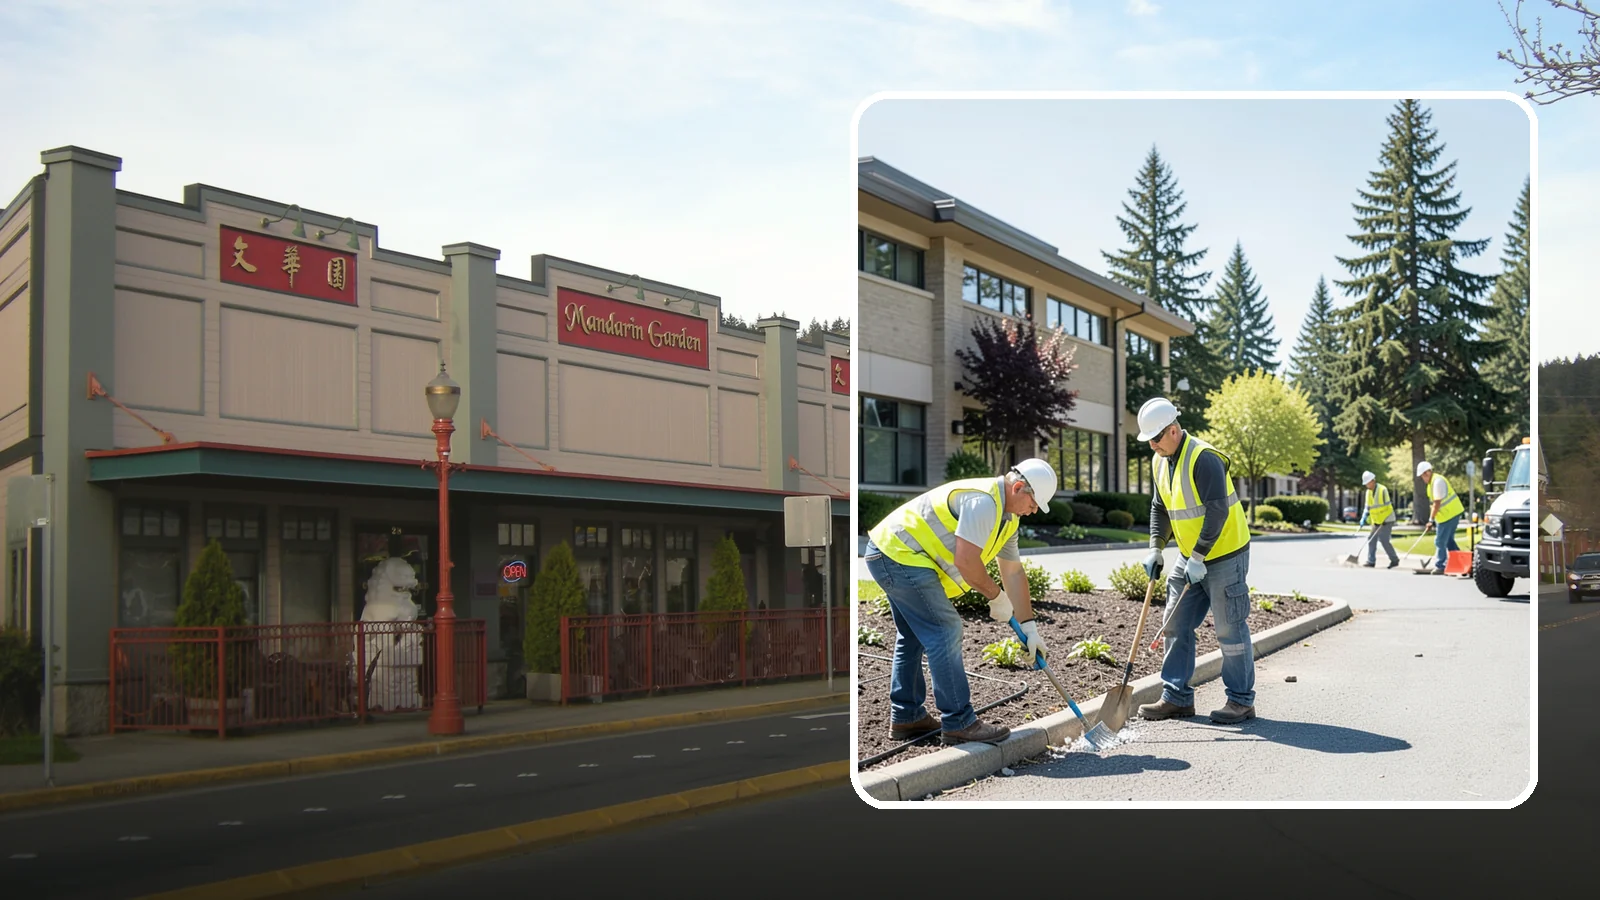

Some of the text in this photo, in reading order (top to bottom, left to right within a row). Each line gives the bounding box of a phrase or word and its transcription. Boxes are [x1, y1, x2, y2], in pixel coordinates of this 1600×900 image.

[230, 235, 346, 291] 文華園
[564, 302, 701, 352] Mandarin Garden
[503, 565, 527, 578] OPEN
